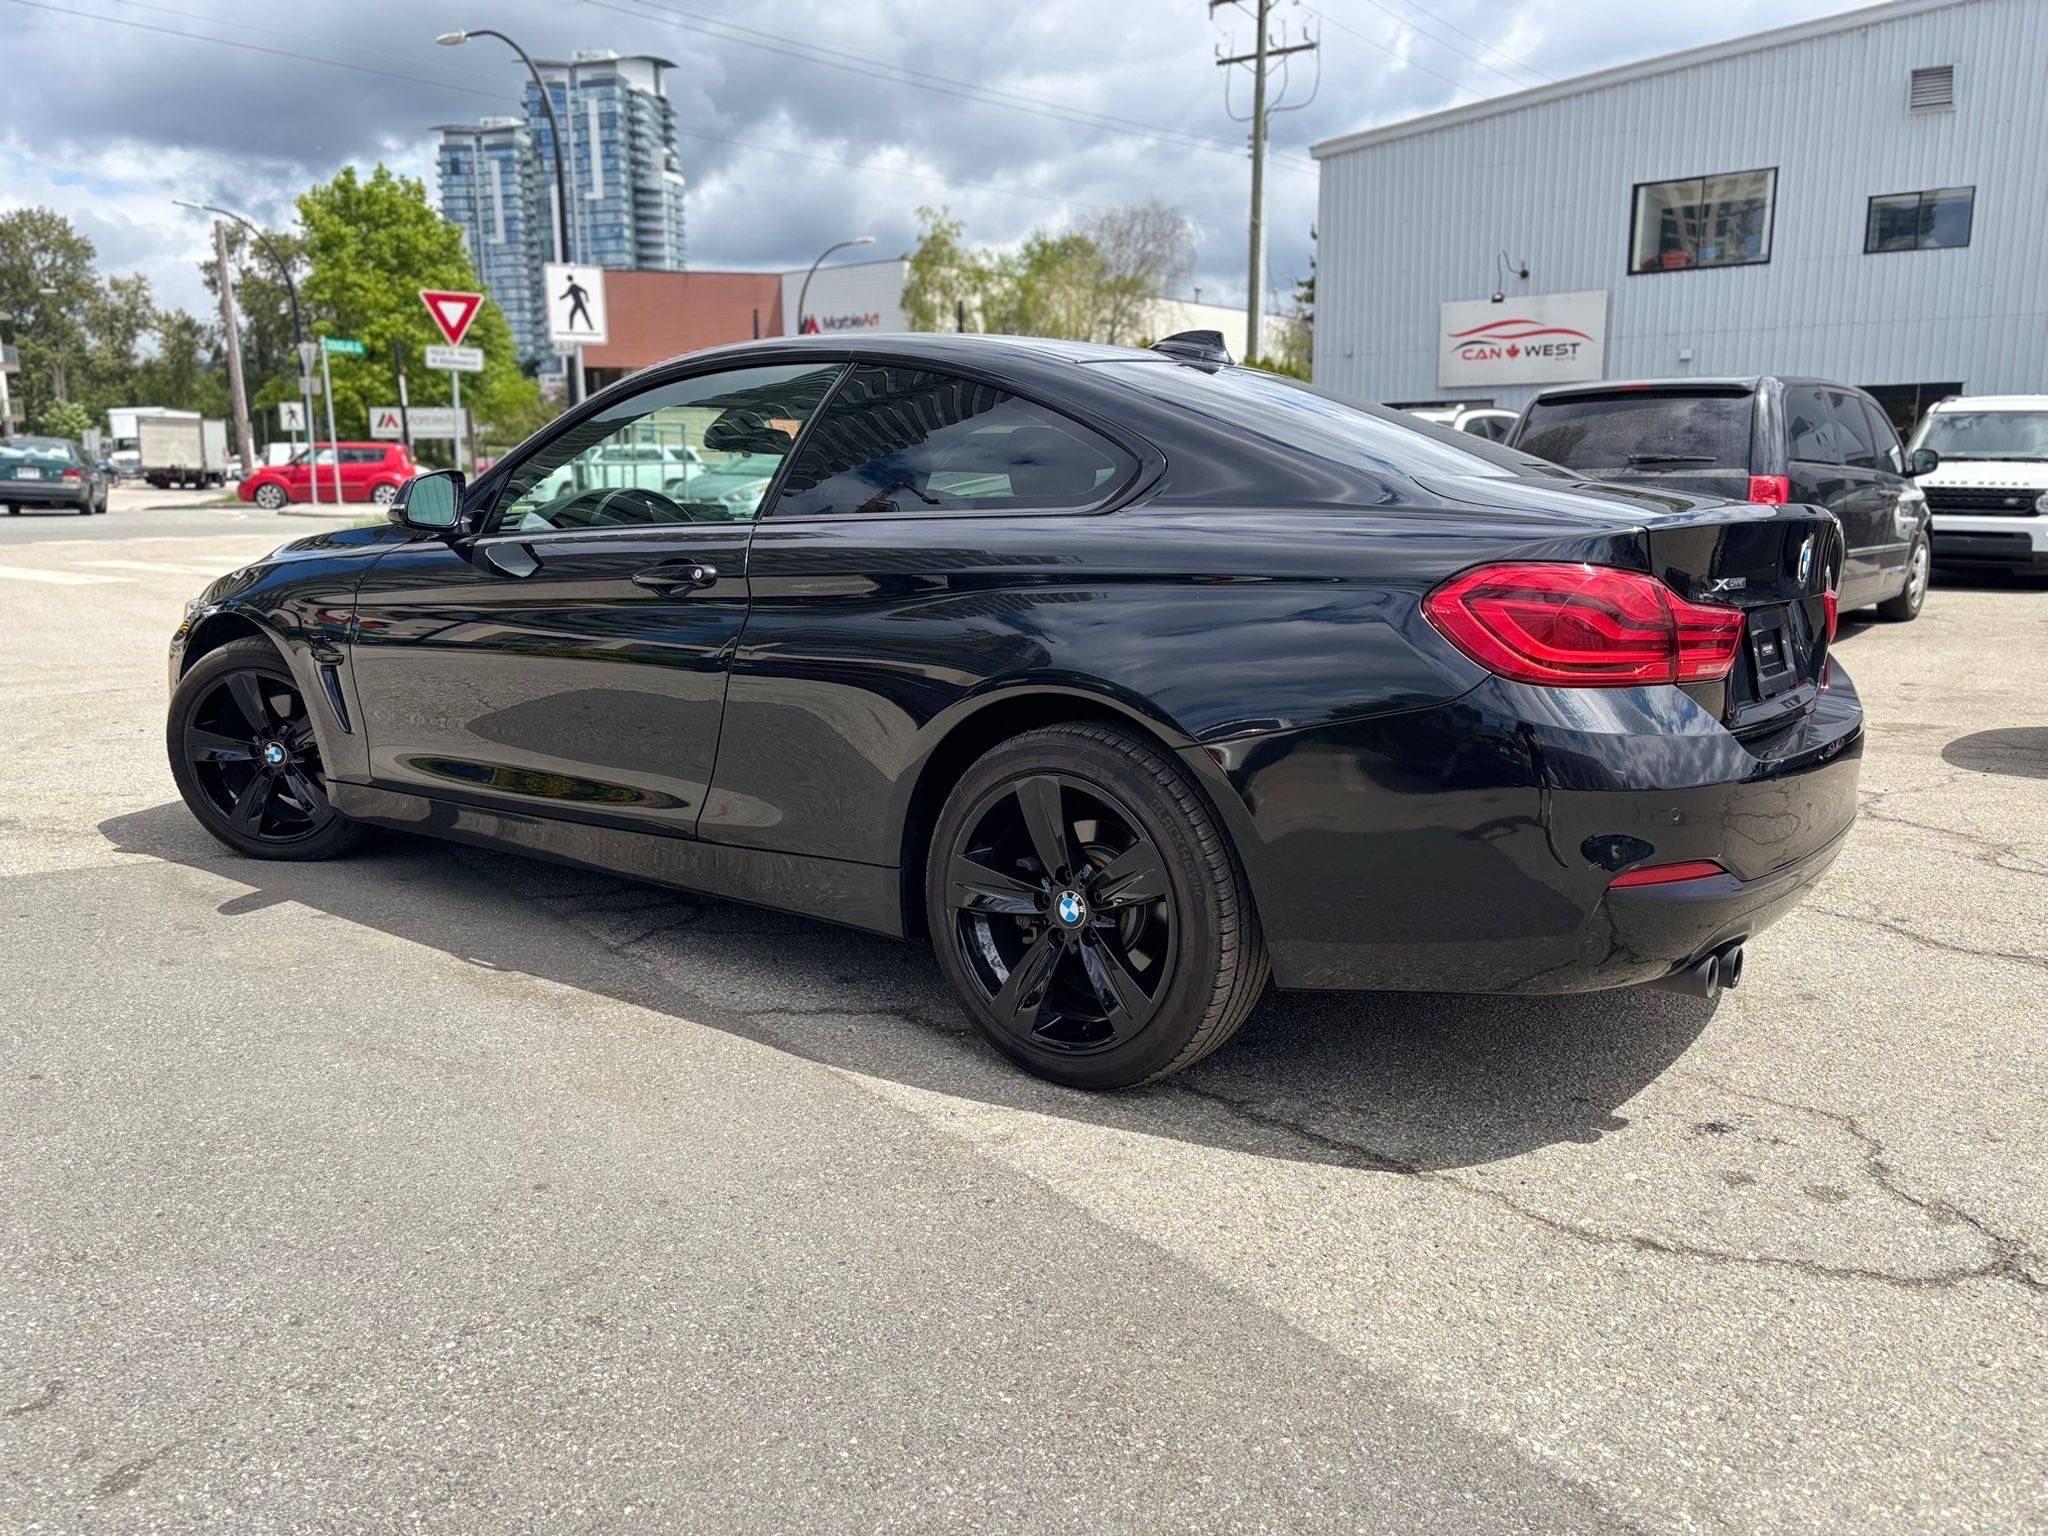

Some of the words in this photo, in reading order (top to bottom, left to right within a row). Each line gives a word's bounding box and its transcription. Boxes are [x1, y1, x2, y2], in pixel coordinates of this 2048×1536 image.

[1461, 347, 1502, 361] CAN
[1524, 343, 1582, 357] WEST
[1062, 892, 1086, 914] BMW
